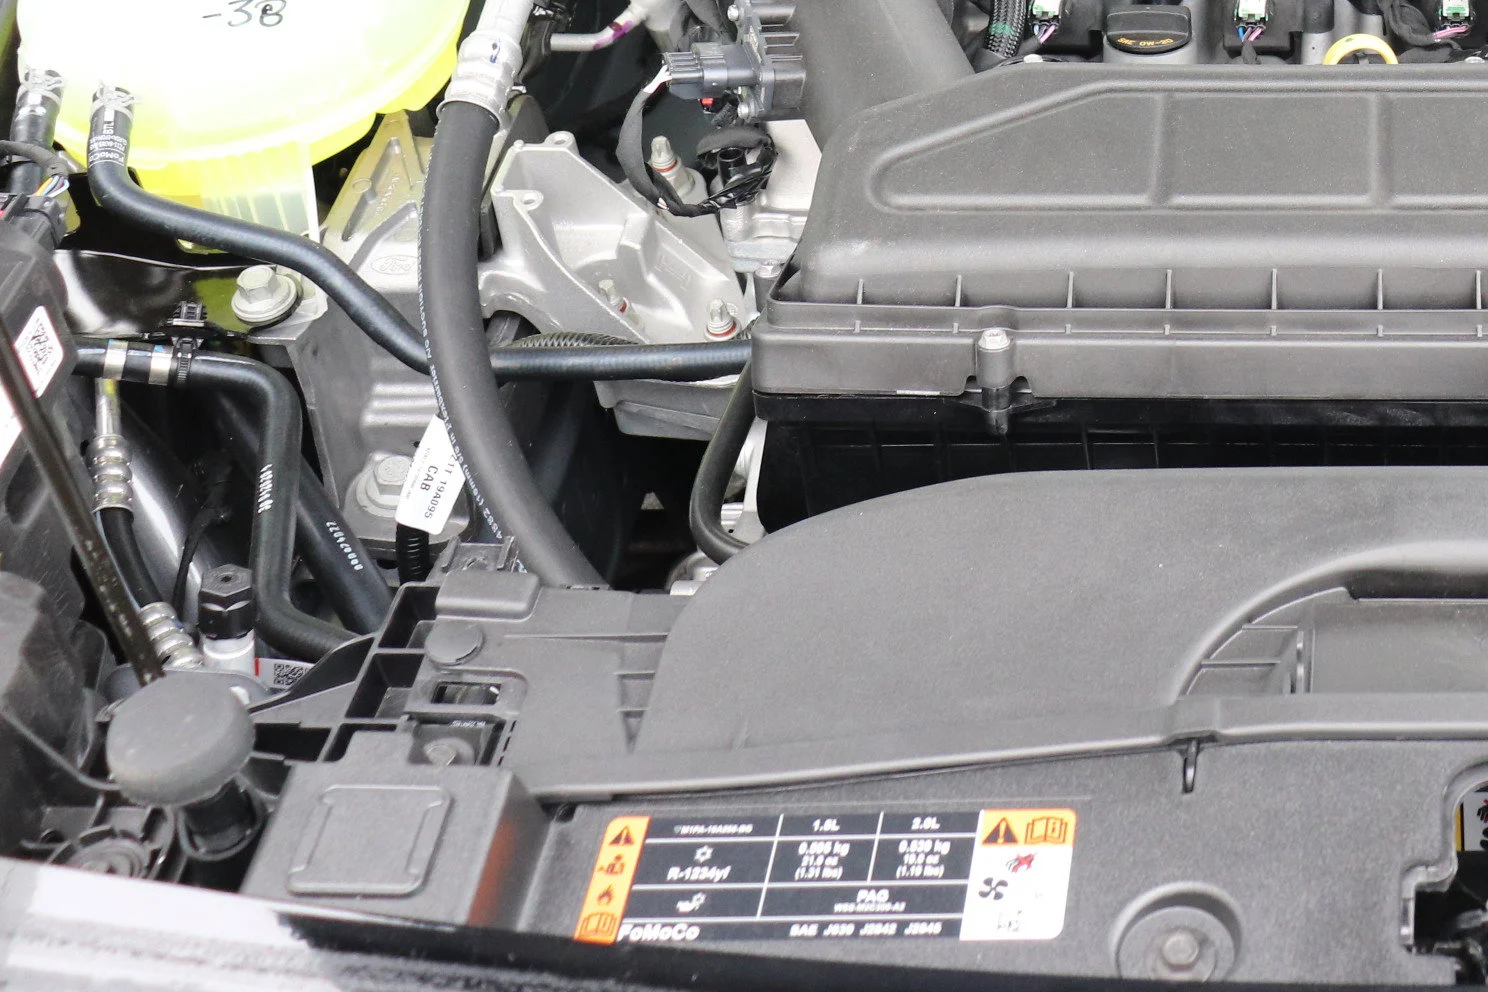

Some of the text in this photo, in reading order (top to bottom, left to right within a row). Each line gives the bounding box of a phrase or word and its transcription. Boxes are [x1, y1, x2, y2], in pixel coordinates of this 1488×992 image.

[1117, 37, 1135, 45] SAE
[420, 465, 438, 491] CAB
[424, 480, 447, 519] 19A095
[911, 816, 941, 831] 2.0L
[833, 841, 851, 857] kg
[933, 839, 951, 855] kg
[666, 865, 732, 883] R-1234yf
[856, 889, 890, 903] PAG
[616, 923, 701, 942] FoMoCo
[789, 923, 819, 937] SAE
